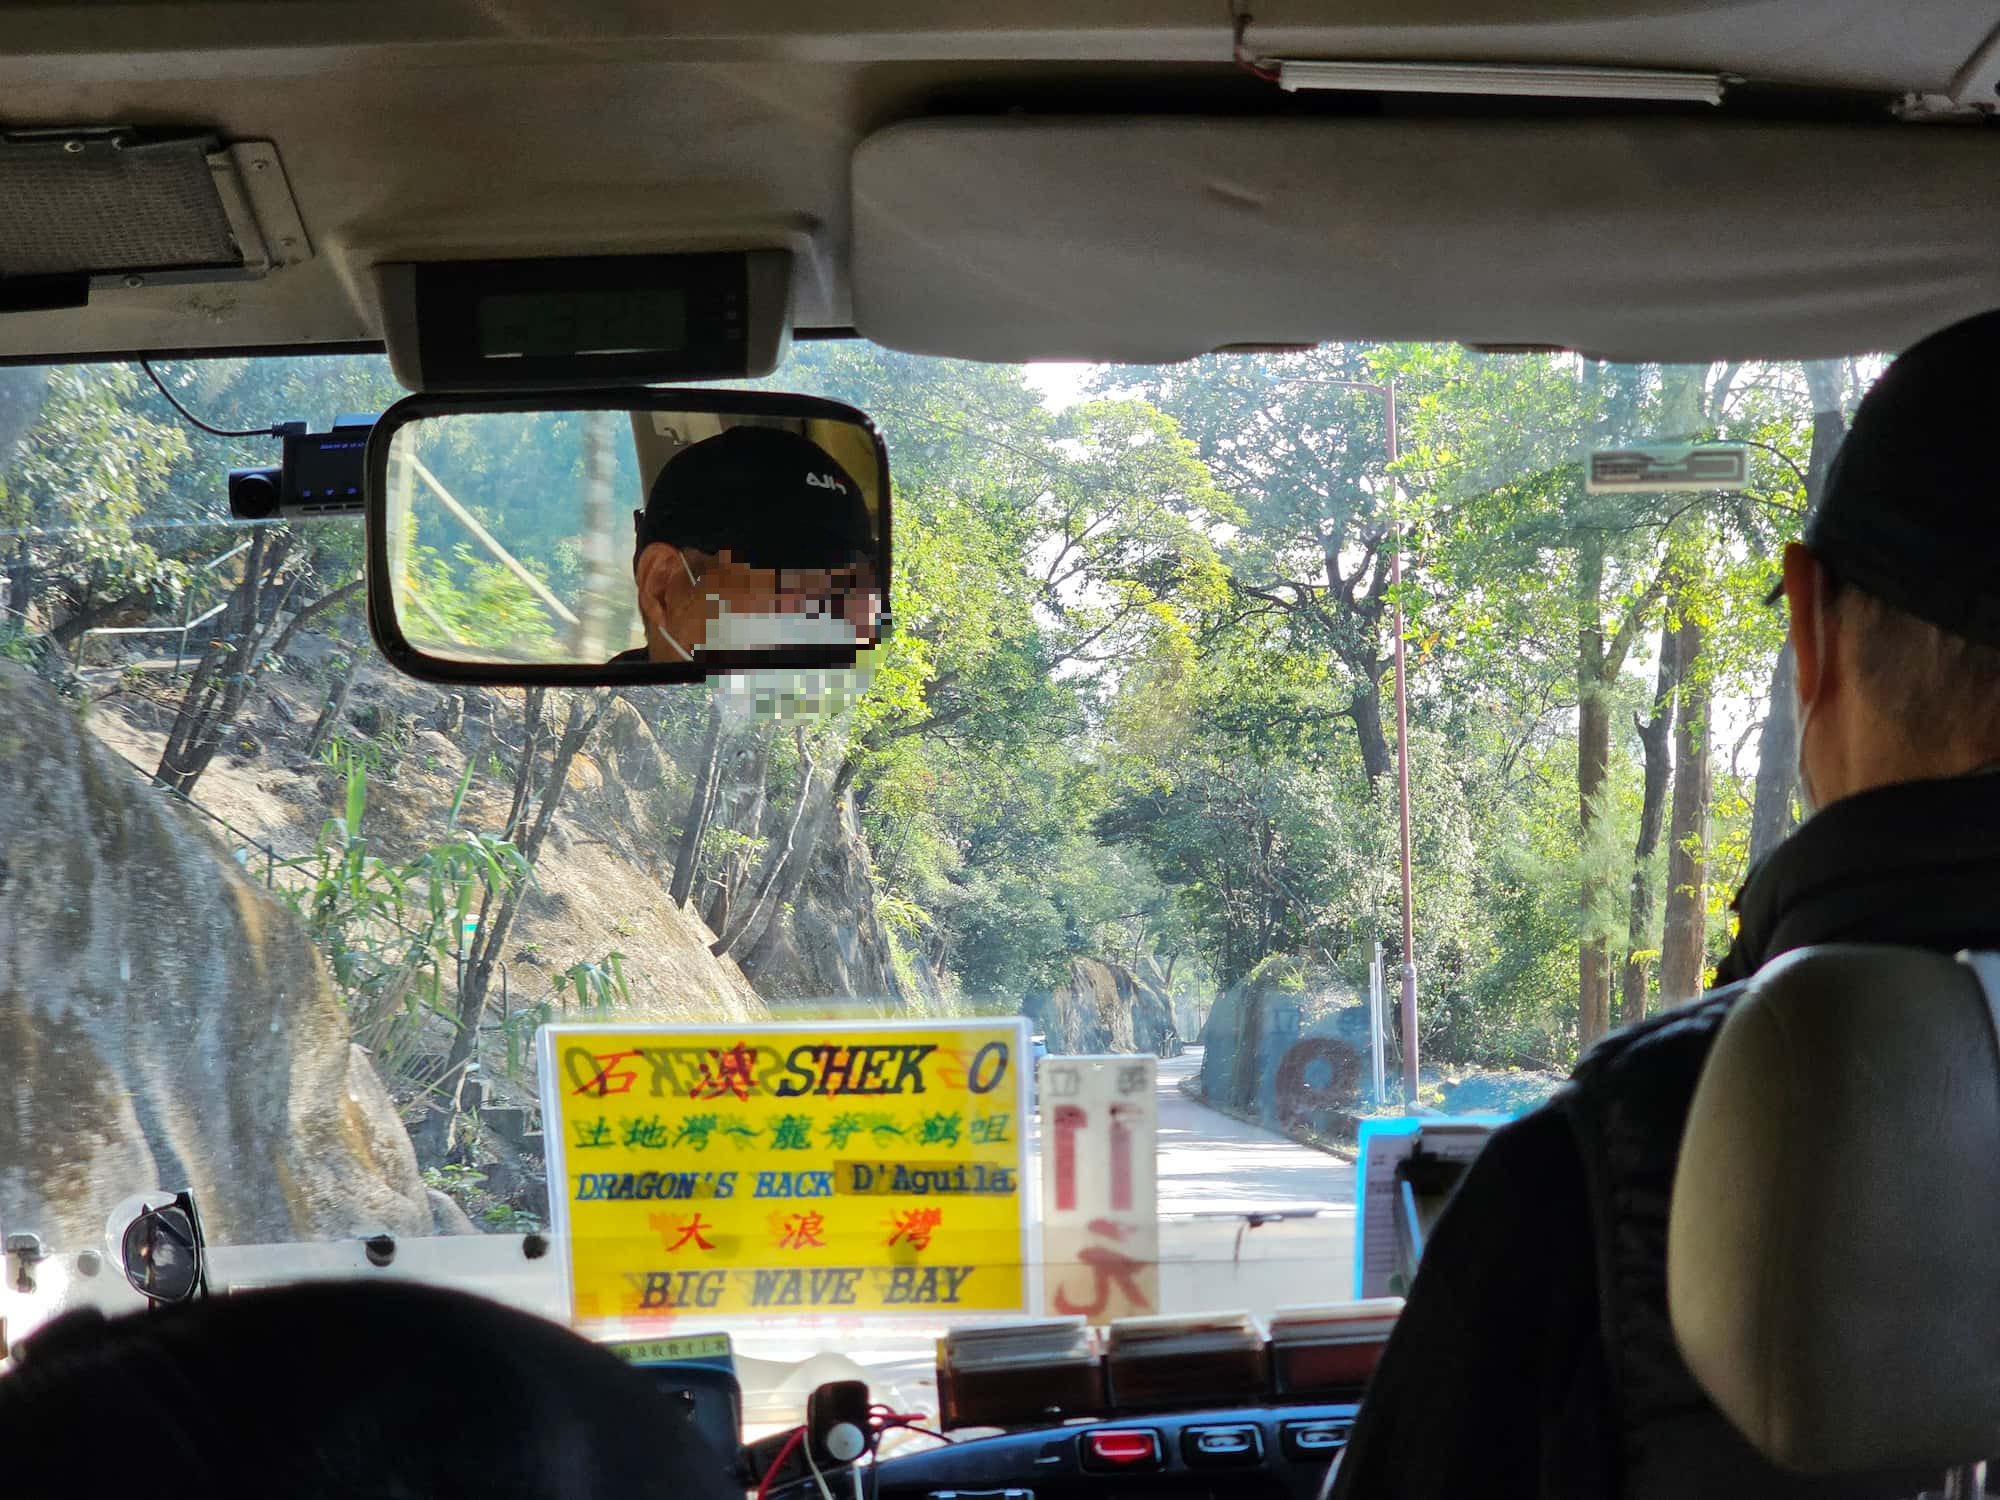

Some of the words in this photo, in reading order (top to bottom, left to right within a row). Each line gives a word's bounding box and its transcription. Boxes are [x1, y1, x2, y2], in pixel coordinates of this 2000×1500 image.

[572, 1040, 760, 1101] 石澳
[775, 1044, 938, 1096] SHEK
[967, 1041, 1010, 1095] O
[576, 1171, 738, 1200] DRAGON'S
[753, 1170, 834, 1198] BACK
[638, 1269, 728, 1309] BIG
[750, 1267, 864, 1306] WAVE
[882, 1265, 975, 1305] BAY
